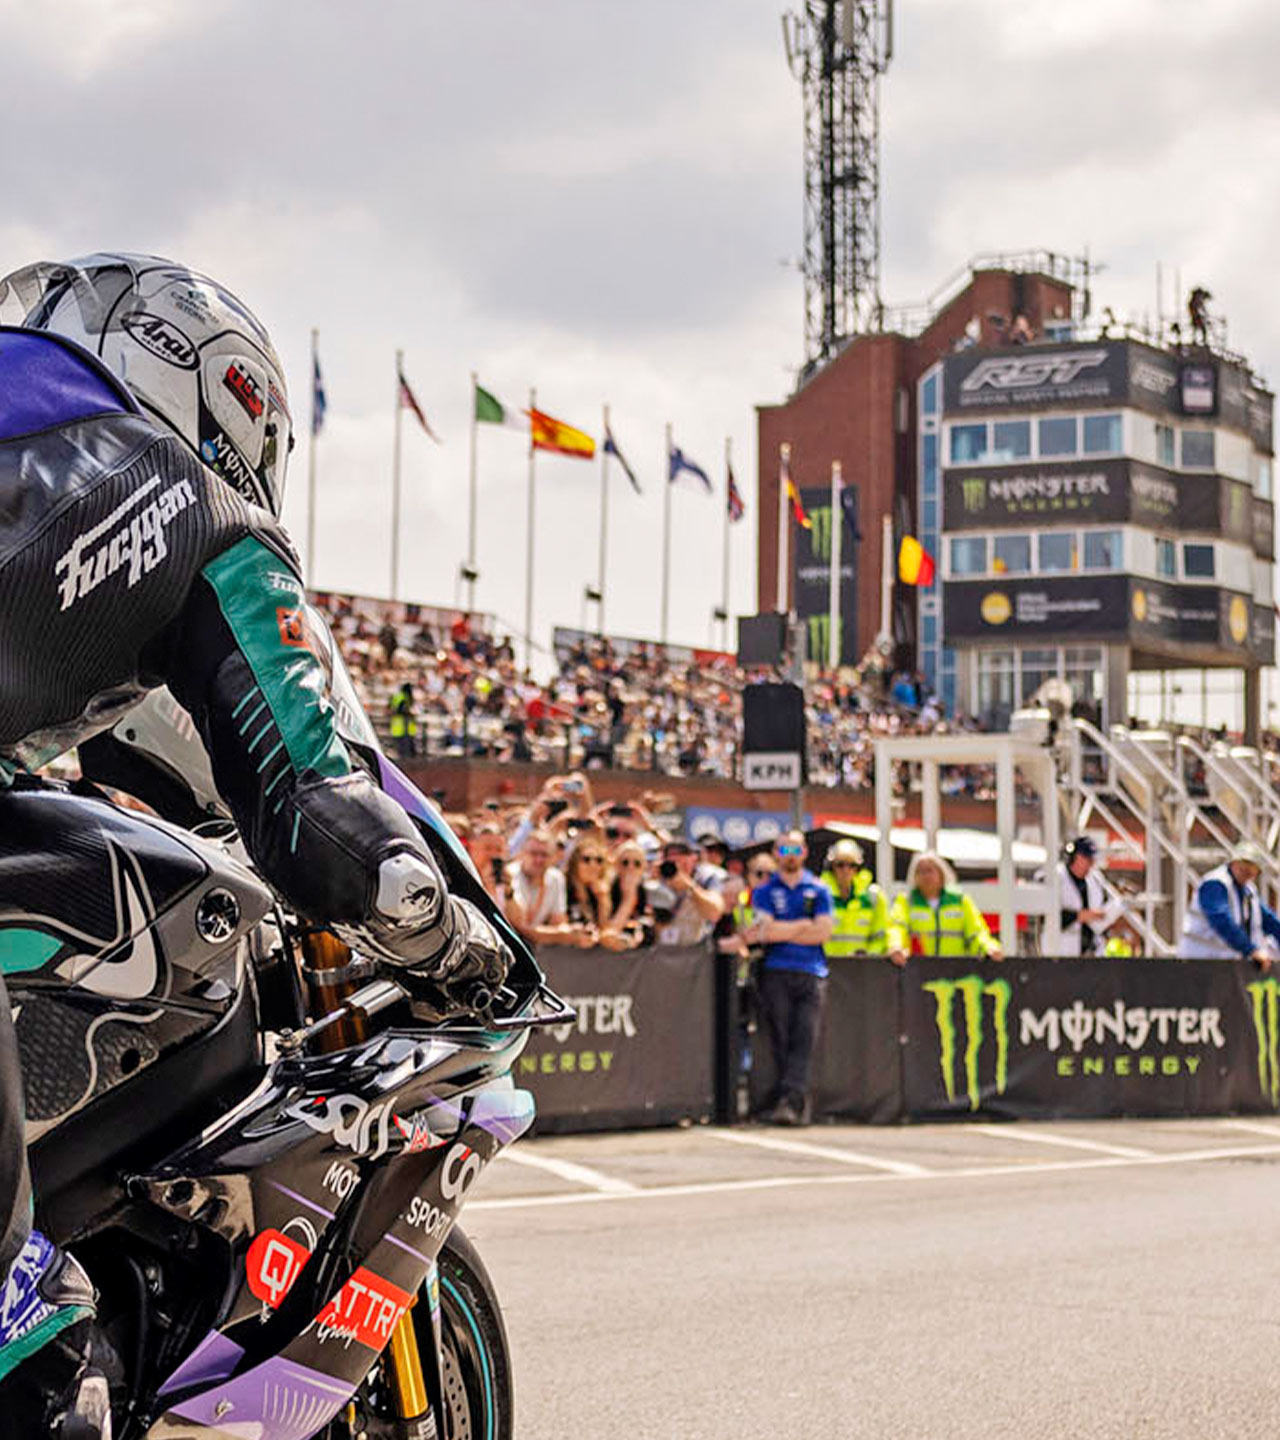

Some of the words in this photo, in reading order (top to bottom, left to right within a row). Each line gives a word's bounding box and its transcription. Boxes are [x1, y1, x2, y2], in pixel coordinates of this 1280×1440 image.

[751, 764, 793, 779] KPH
[1020, 999, 1225, 1052] MONSTER
[520, 1050, 614, 1075] NERGY
[1056, 1055, 1200, 1076] ENERGY
[322, 1160, 362, 1200] MOT
